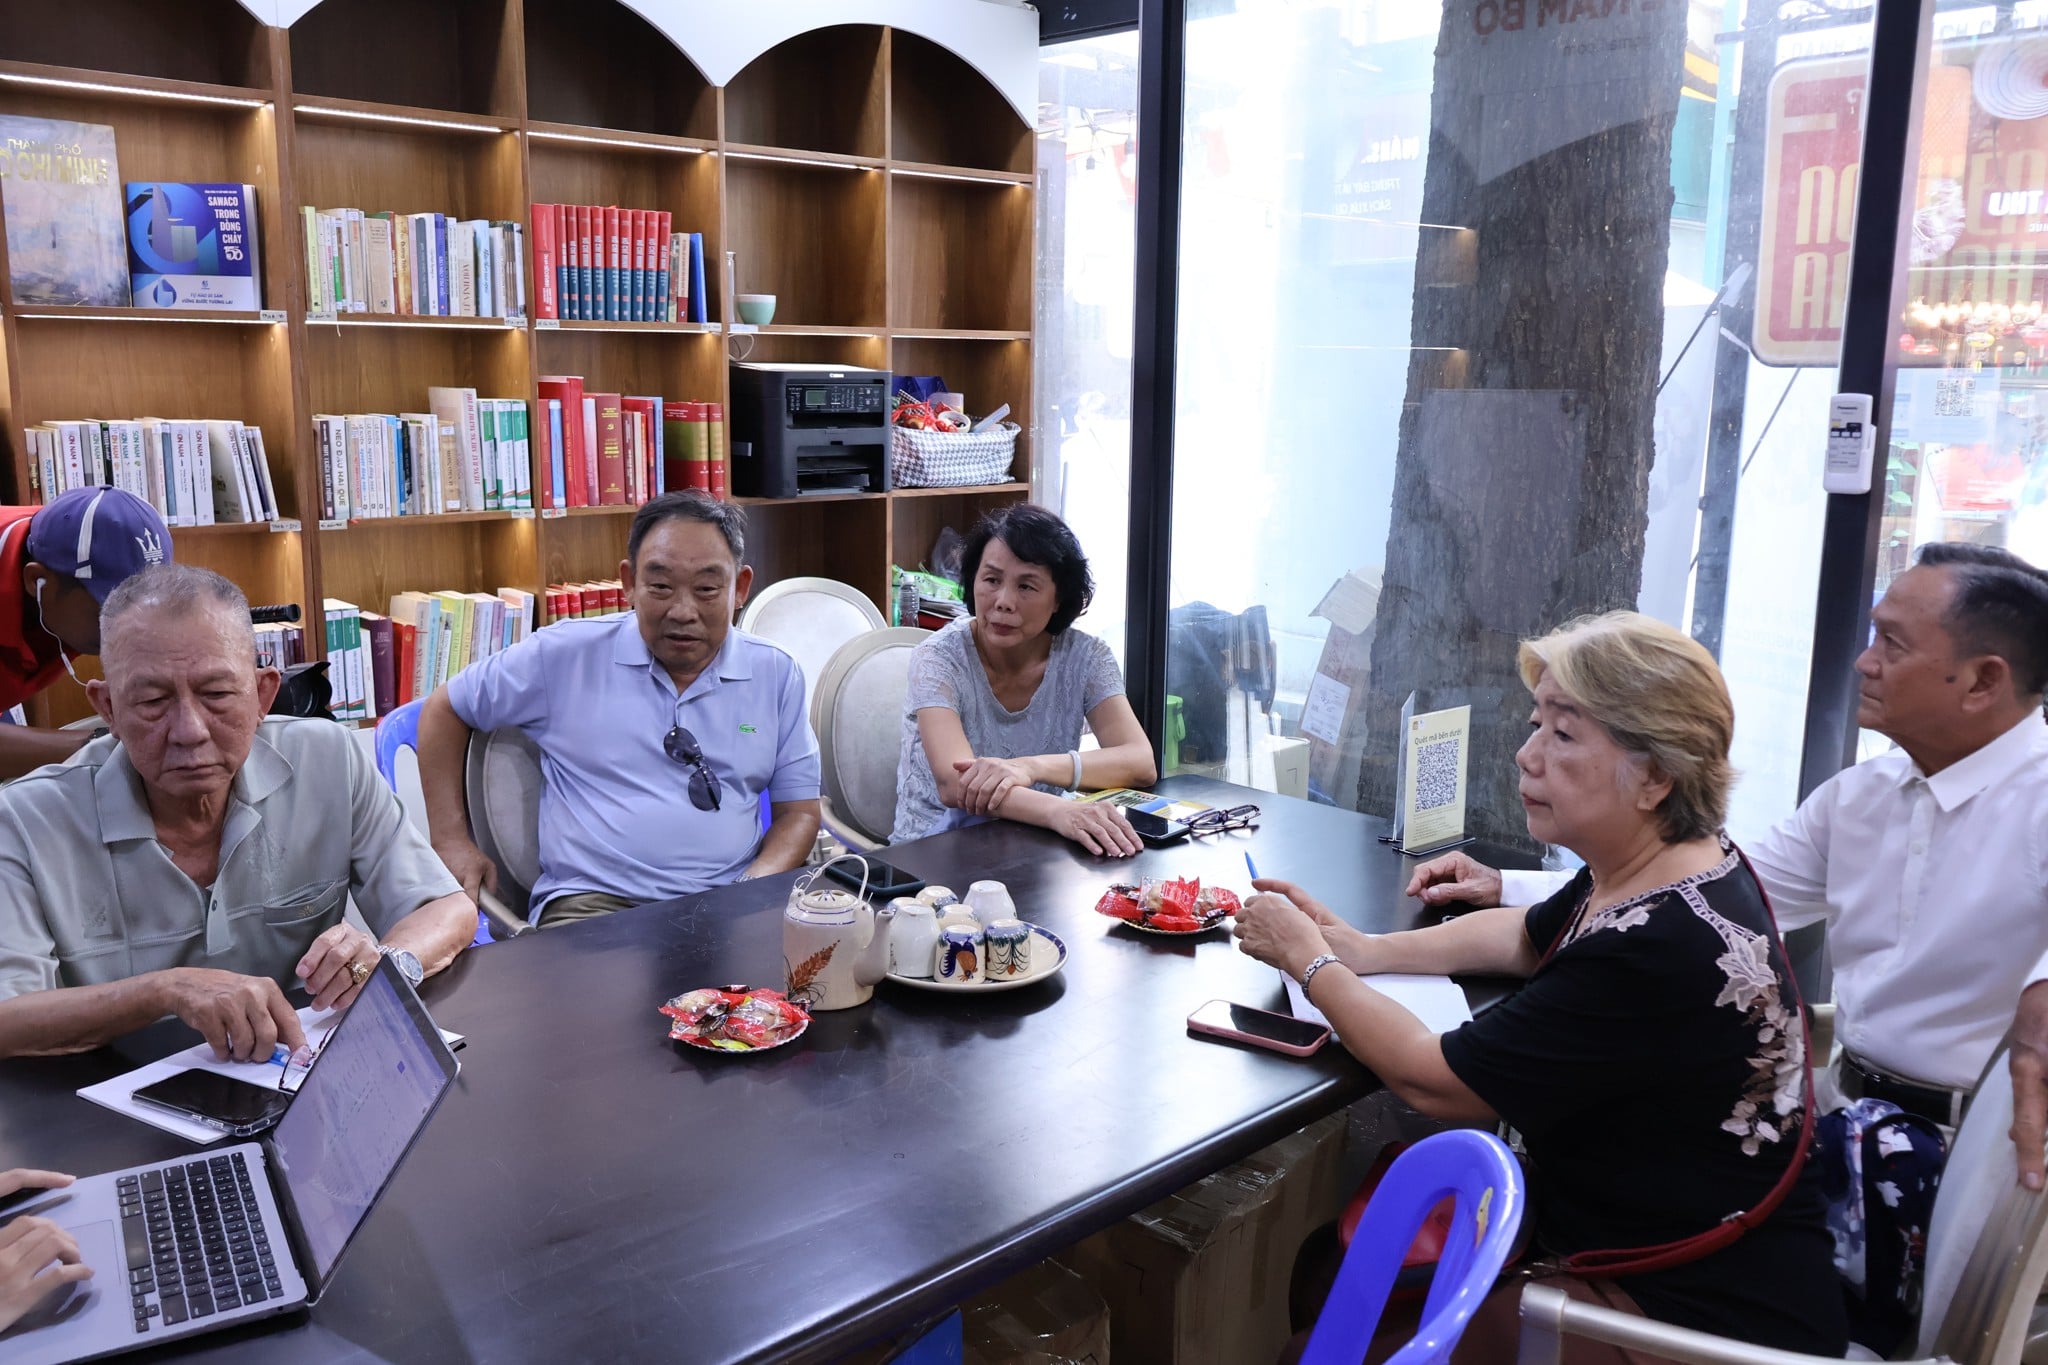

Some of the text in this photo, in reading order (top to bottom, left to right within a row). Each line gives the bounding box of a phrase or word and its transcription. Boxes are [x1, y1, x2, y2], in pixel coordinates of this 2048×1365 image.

[207, 196, 239, 207] SAWACO
[214, 209, 240, 219] TRONG
[220, 220, 241, 232] DÒNG
